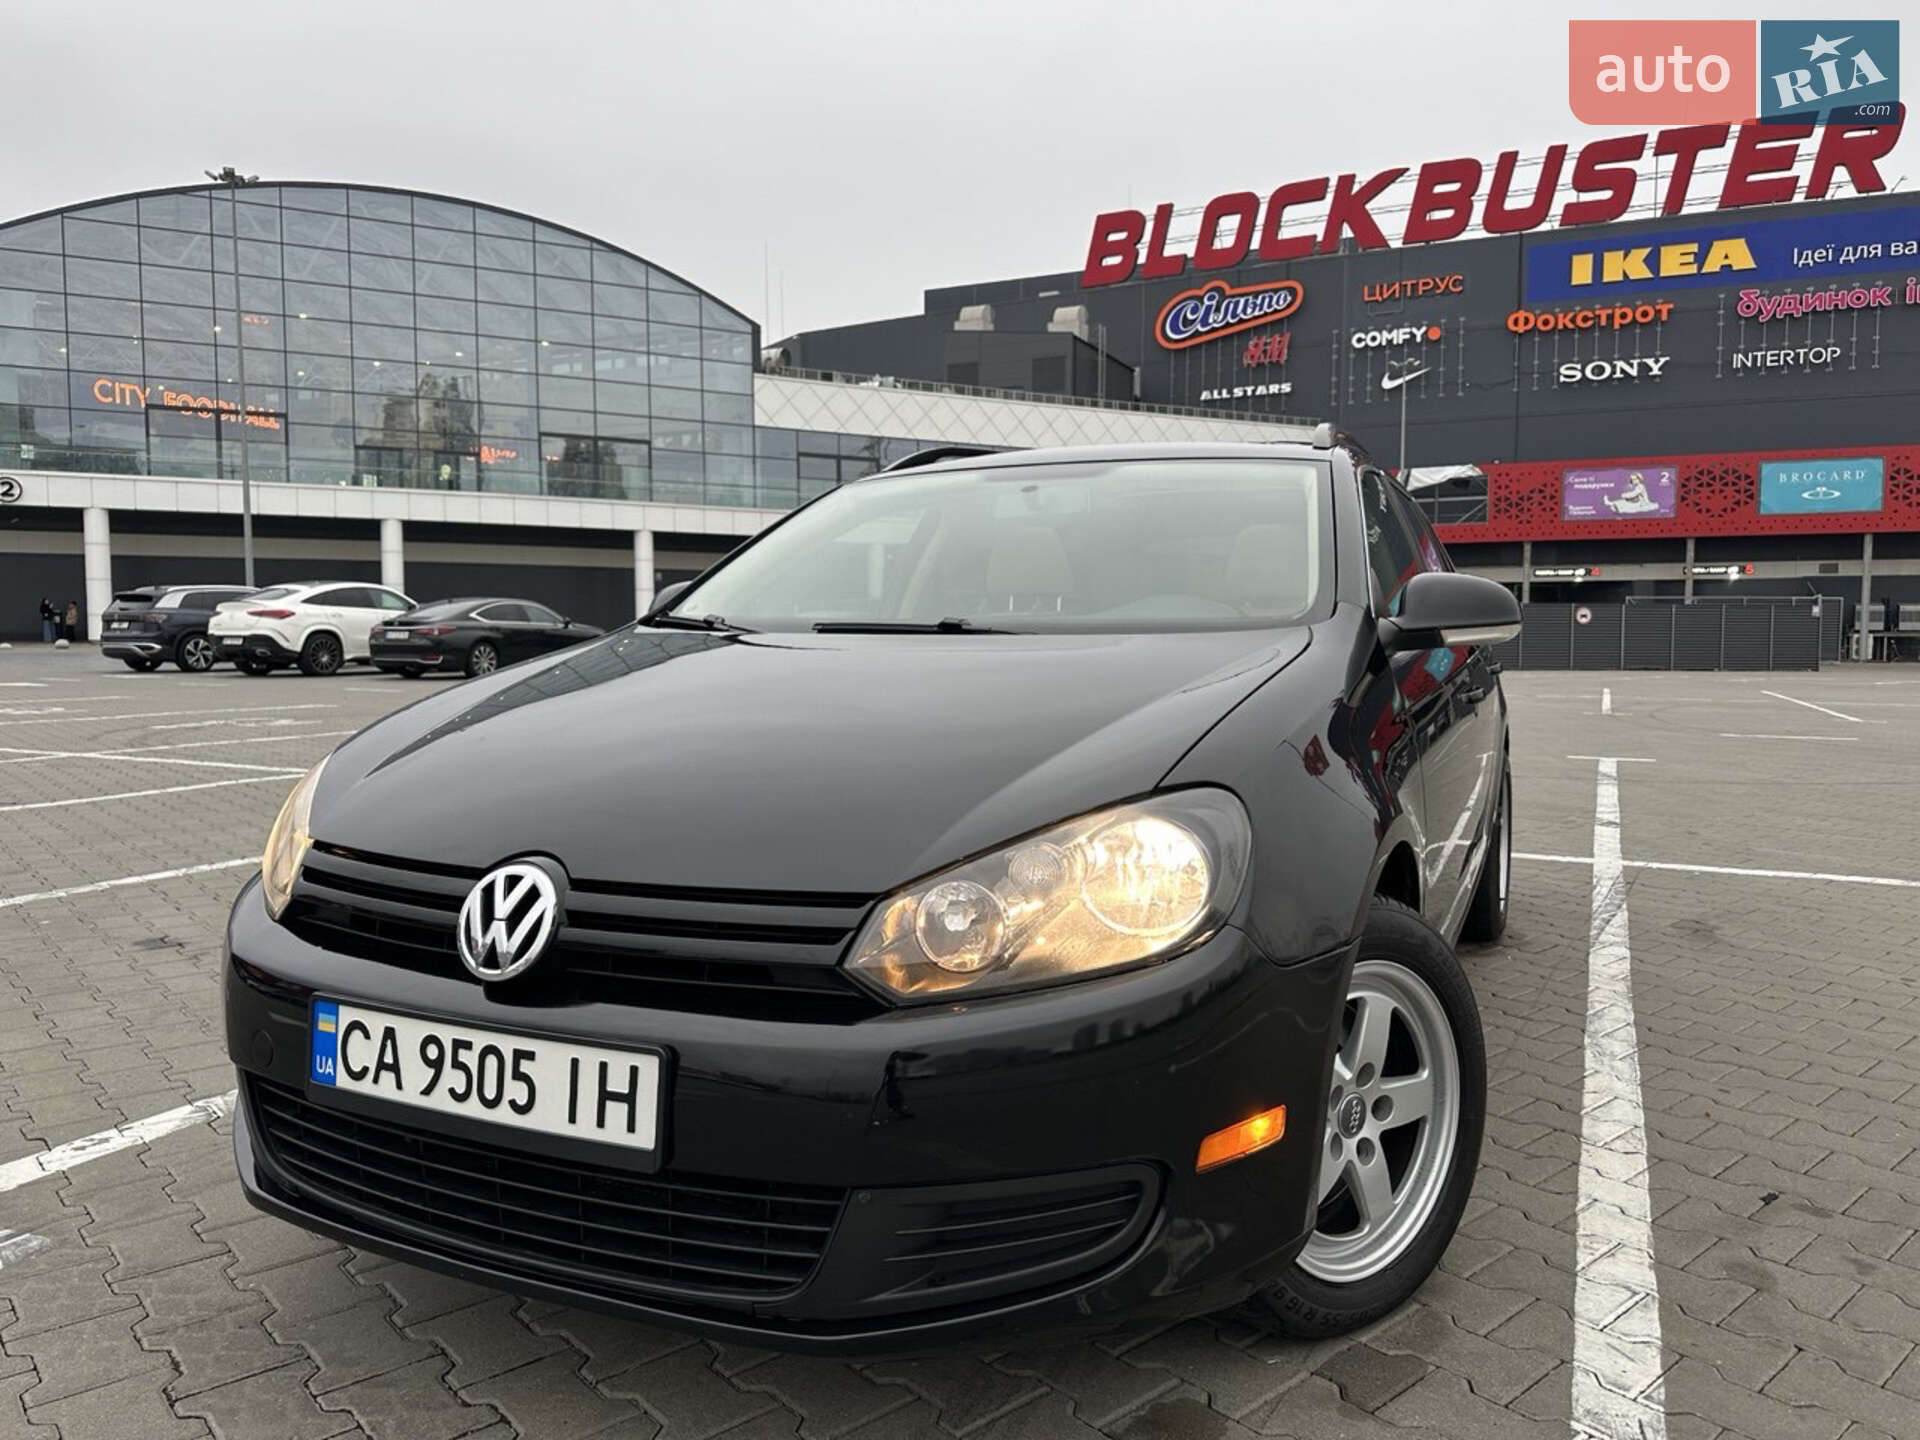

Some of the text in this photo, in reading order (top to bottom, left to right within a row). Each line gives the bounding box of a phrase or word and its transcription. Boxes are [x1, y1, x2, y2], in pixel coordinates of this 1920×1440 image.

[1080, 101, 1906, 289] BLOCKBUSTER
[1570, 238, 1757, 286] IKEA
[1793, 245, 1834, 268] Ідеї
[1839, 243, 1882, 264] для
[1363, 274, 1464, 304] ЦИТРУС
[1165, 287, 1292, 340] Сільпо
[1507, 300, 1675, 334] Фокстрот
[1737, 286, 1892, 322] будинок
[1351, 325, 1428, 350] COMFY
[1559, 357, 1671, 383] SONY
[1732, 346, 1841, 369] INTERTOP
[93, 378, 151, 408] CITY
[1200, 381, 1293, 401] ALL STARS
[0, 481, 15, 497] 2
[1660, 471, 1670, 483] 2
[1778, 470, 1866, 483] BROCARD
[315, 1055, 335, 1077] UA
[420, 1033, 536, 1116] 9505
